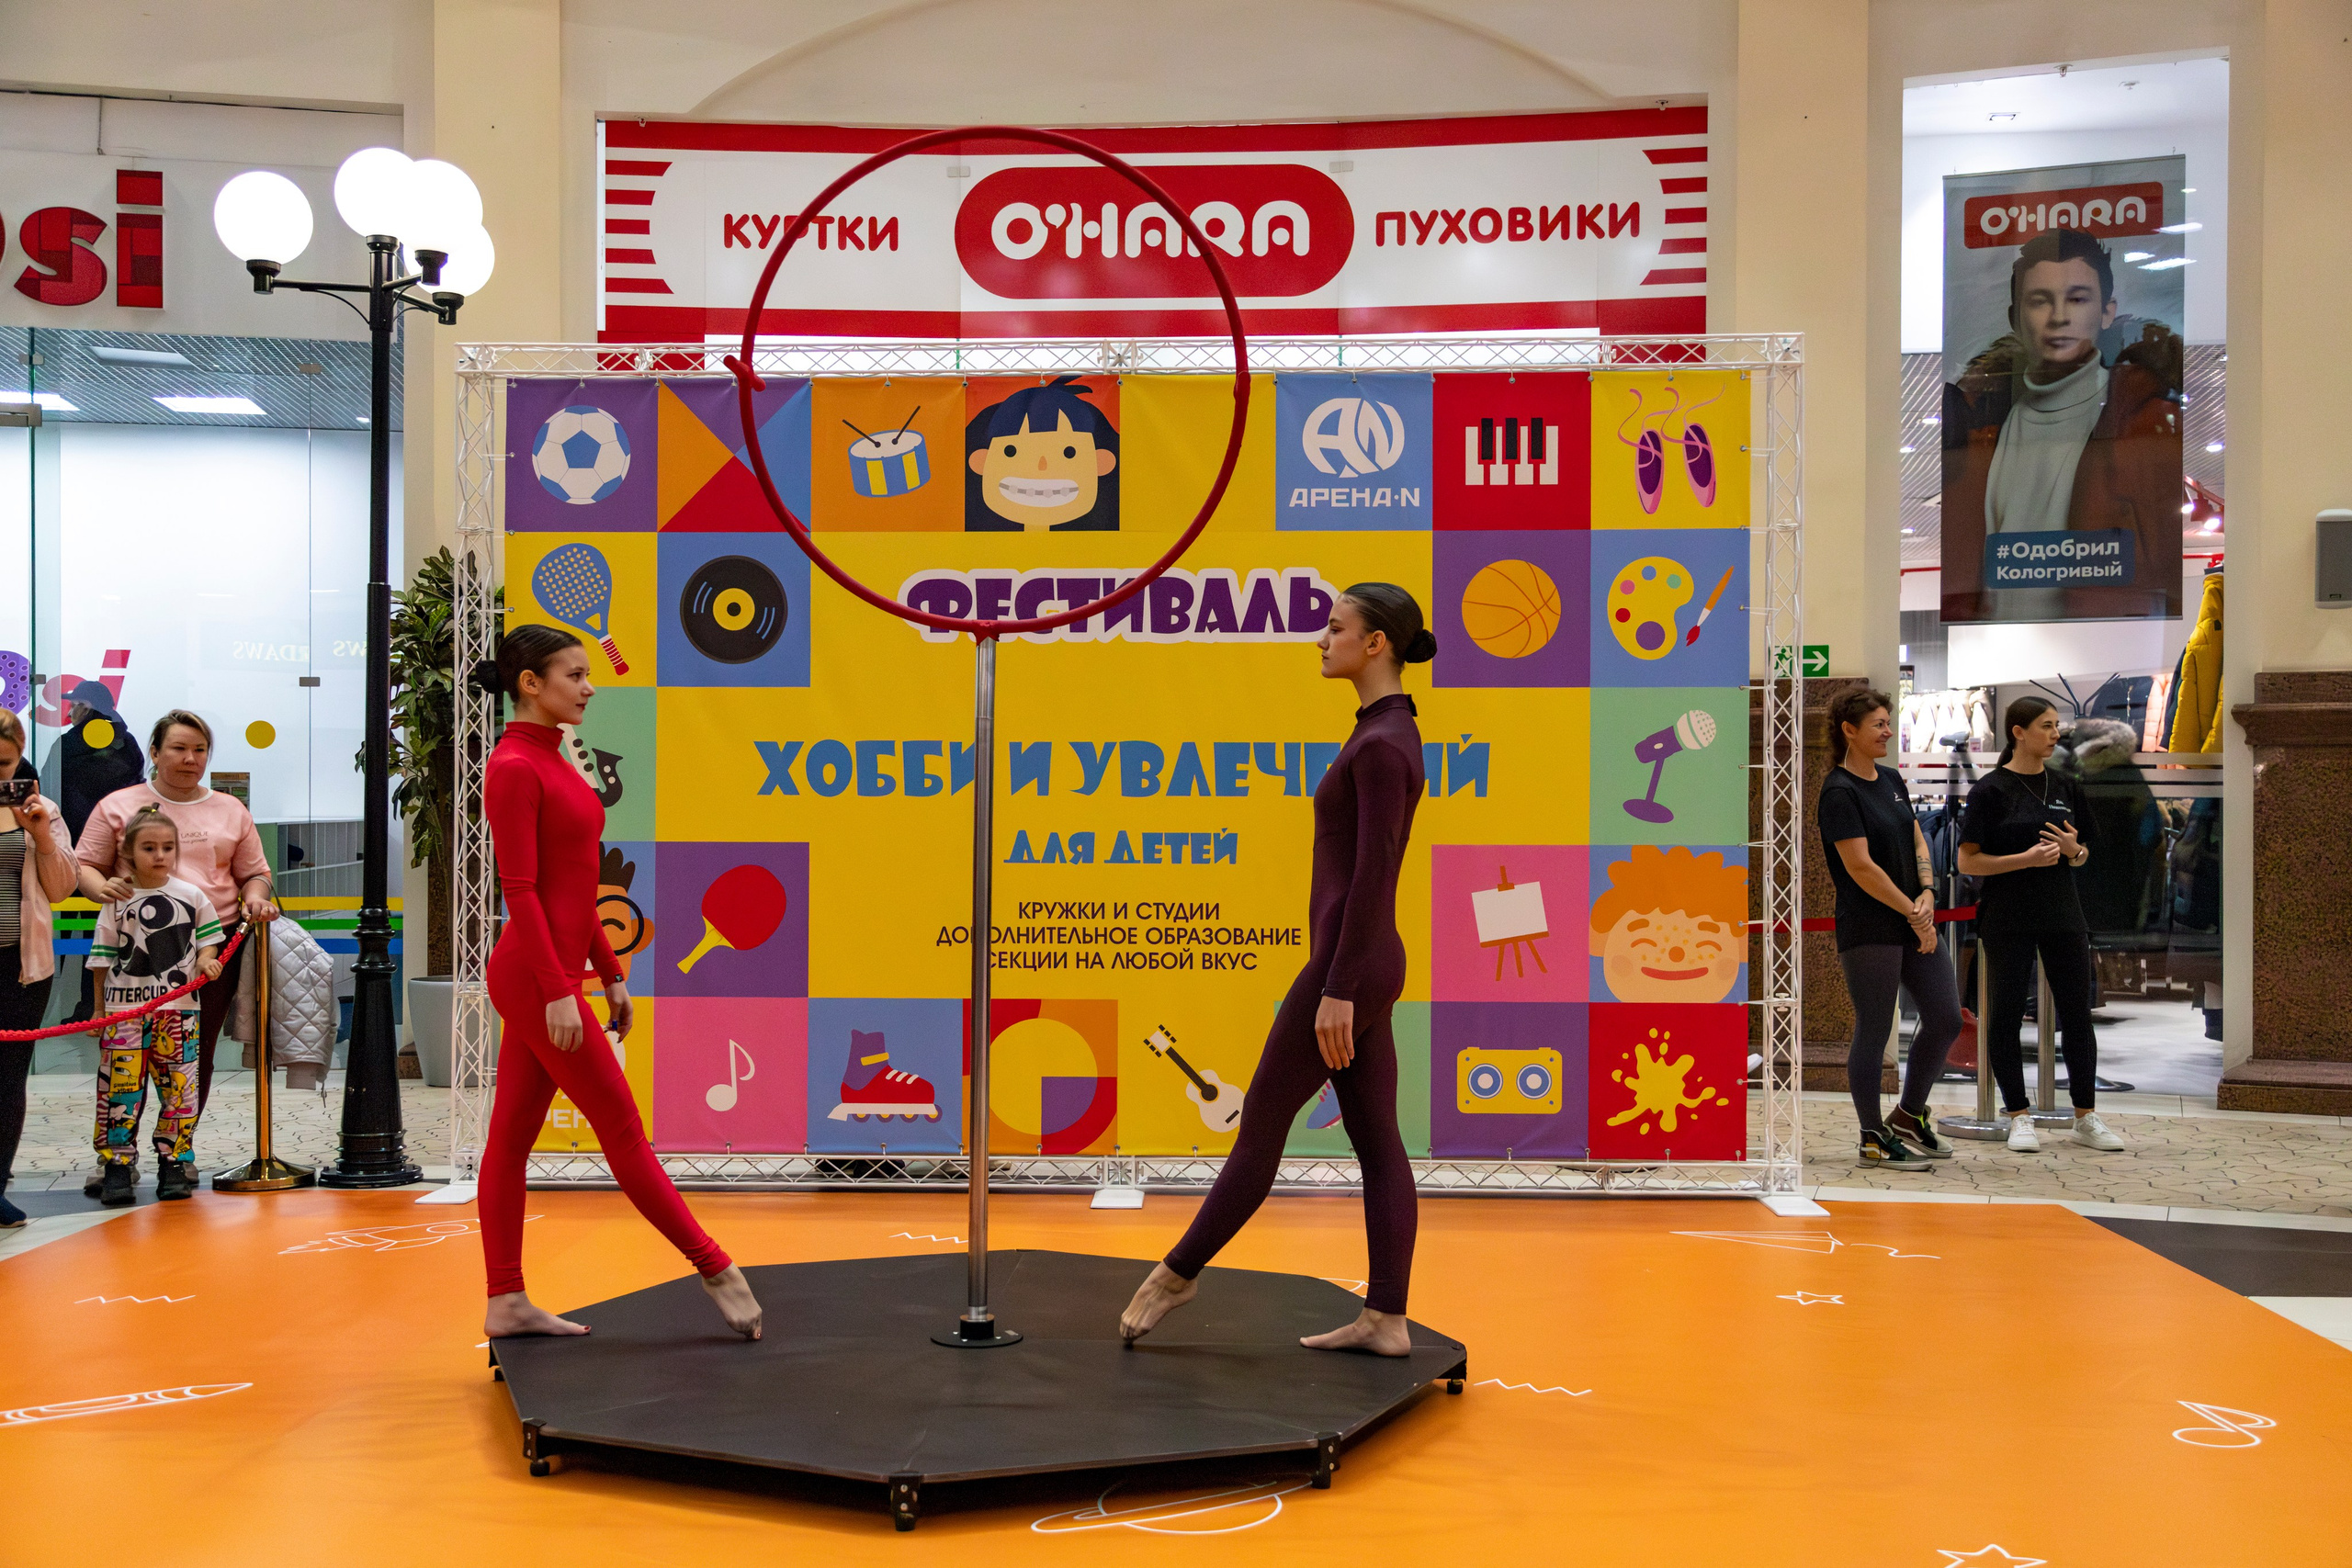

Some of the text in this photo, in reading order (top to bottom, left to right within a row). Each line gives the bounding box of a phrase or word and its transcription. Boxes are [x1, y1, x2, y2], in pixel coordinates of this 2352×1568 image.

[990, 199, 1311, 260] O'HARA
[1375, 201, 1641, 247] ПУХОВИКИ
[1980, 196, 2147, 236] O'HARA
[0, 168, 164, 310] si
[1996, 538, 2120, 561] #Одобрил
[1996, 561, 2123, 581] Кологривый
[906, 576, 1334, 634] ФЕСТИВАЛЬ
[753, 739, 976, 796] ХОББИ
[1009, 741, 1052, 796] И
[1003, 828, 1238, 865] ДЛЯ ДЕТЕЙ
[1018, 902, 1220, 923] КРУЖКИ И СТУДИИ
[936, 926, 1302, 946] ДООЛНИТЕЛЬНОЕ ОБРАЗОВАНИЕ
[1076, 952, 1105, 970] НА
[1111, 948, 1193, 970] ЛЮБОЙ
[1202, 953, 1258, 970] ВКУС
[105, 986, 169, 1004] UTTERCUP
